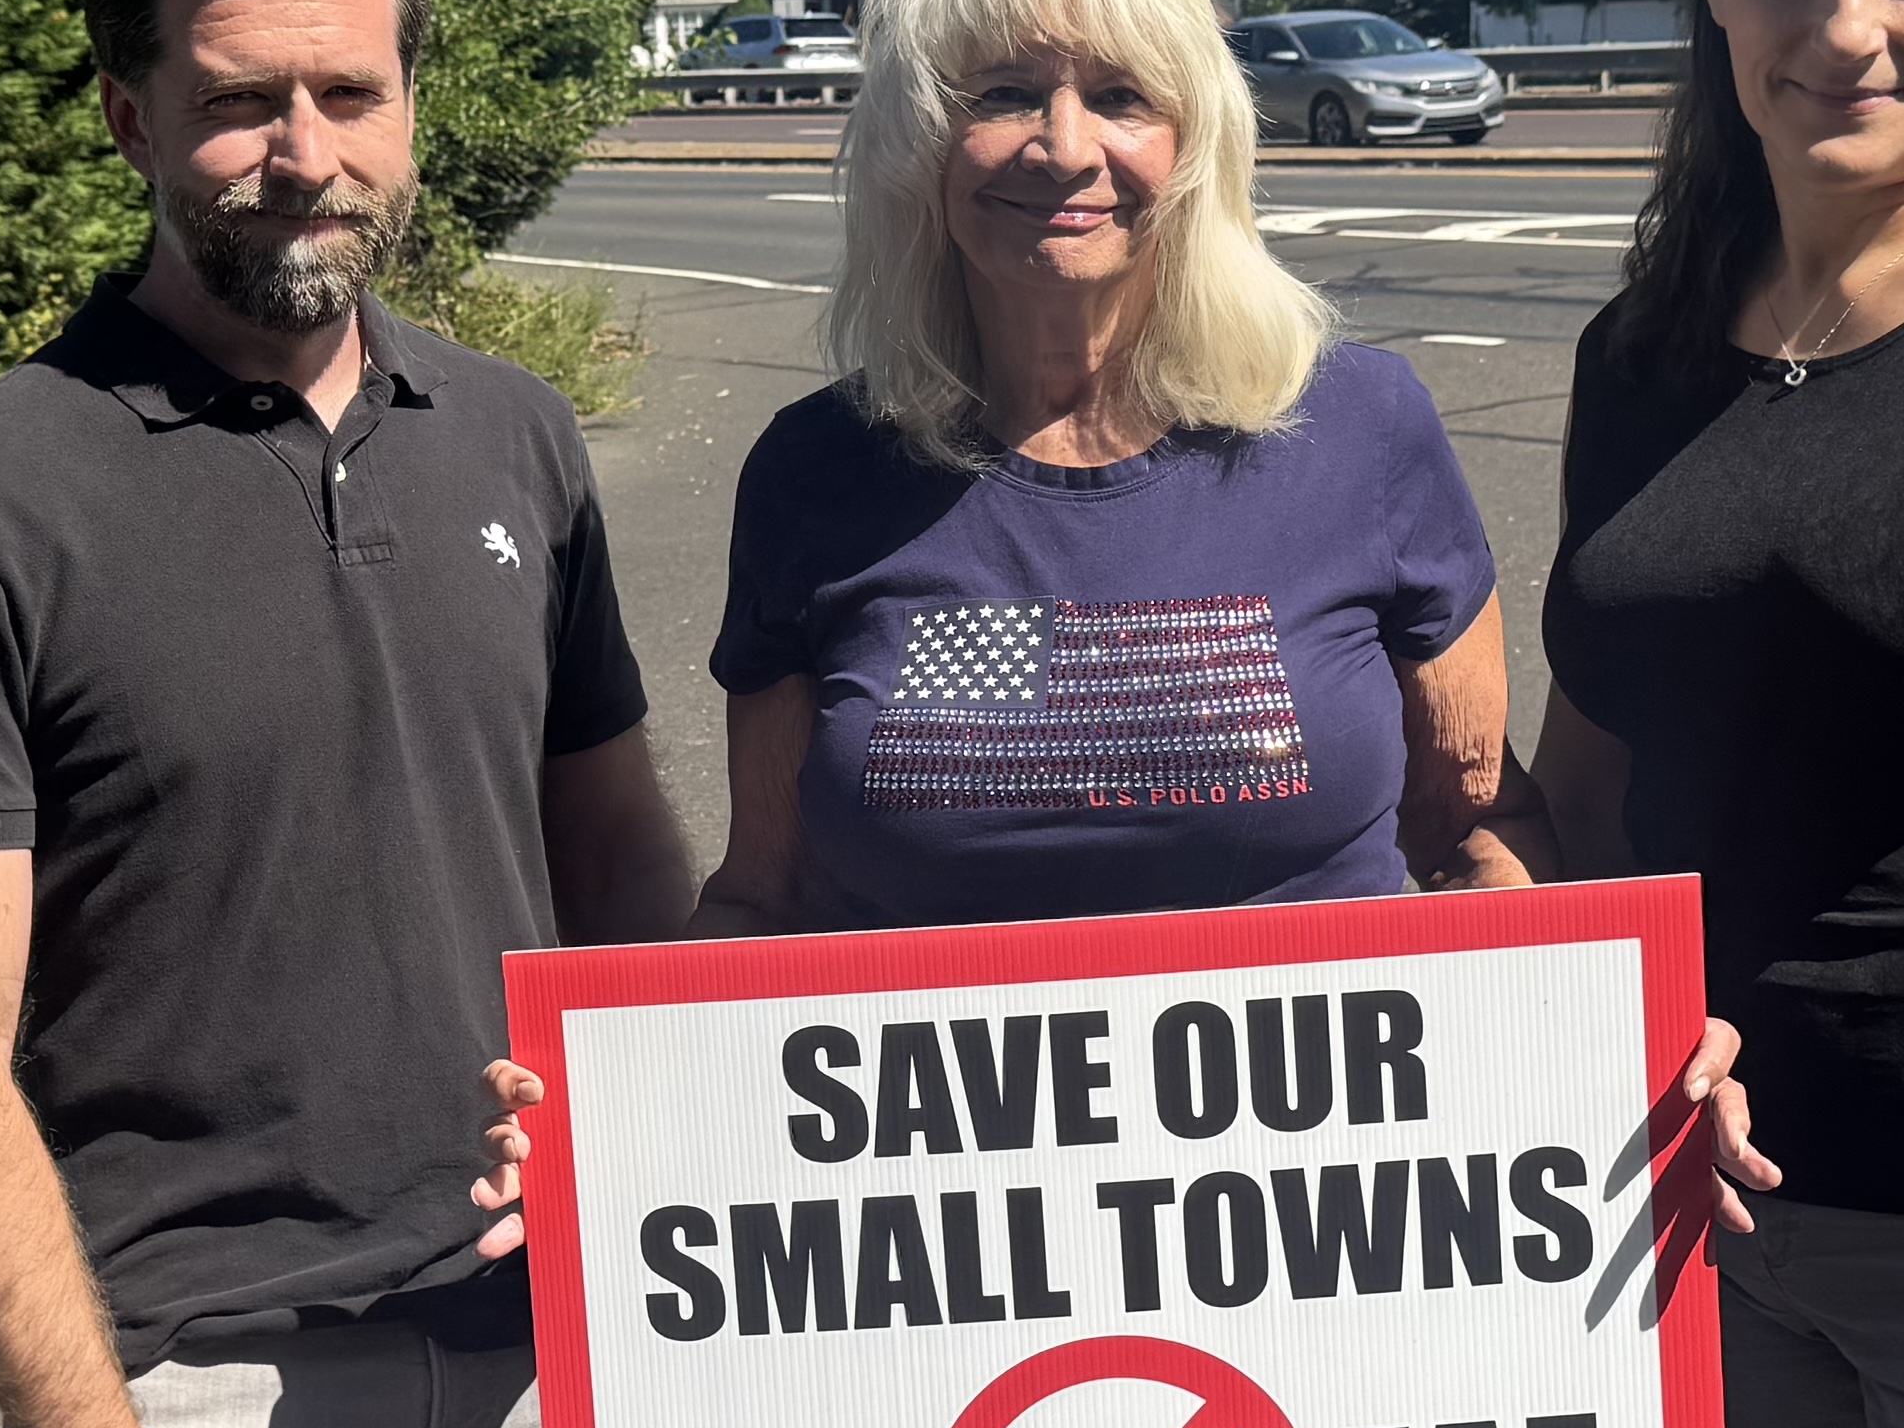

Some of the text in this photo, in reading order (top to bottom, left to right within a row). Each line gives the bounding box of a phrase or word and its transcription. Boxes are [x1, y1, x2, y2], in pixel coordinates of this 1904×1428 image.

[1149, 784, 1228, 806] POLO
[1238, 778, 1314, 802] ASSN.
[781, 989, 1428, 1164] SAVE OUR
[640, 1146, 1594, 1342] SMALL TOWNS
